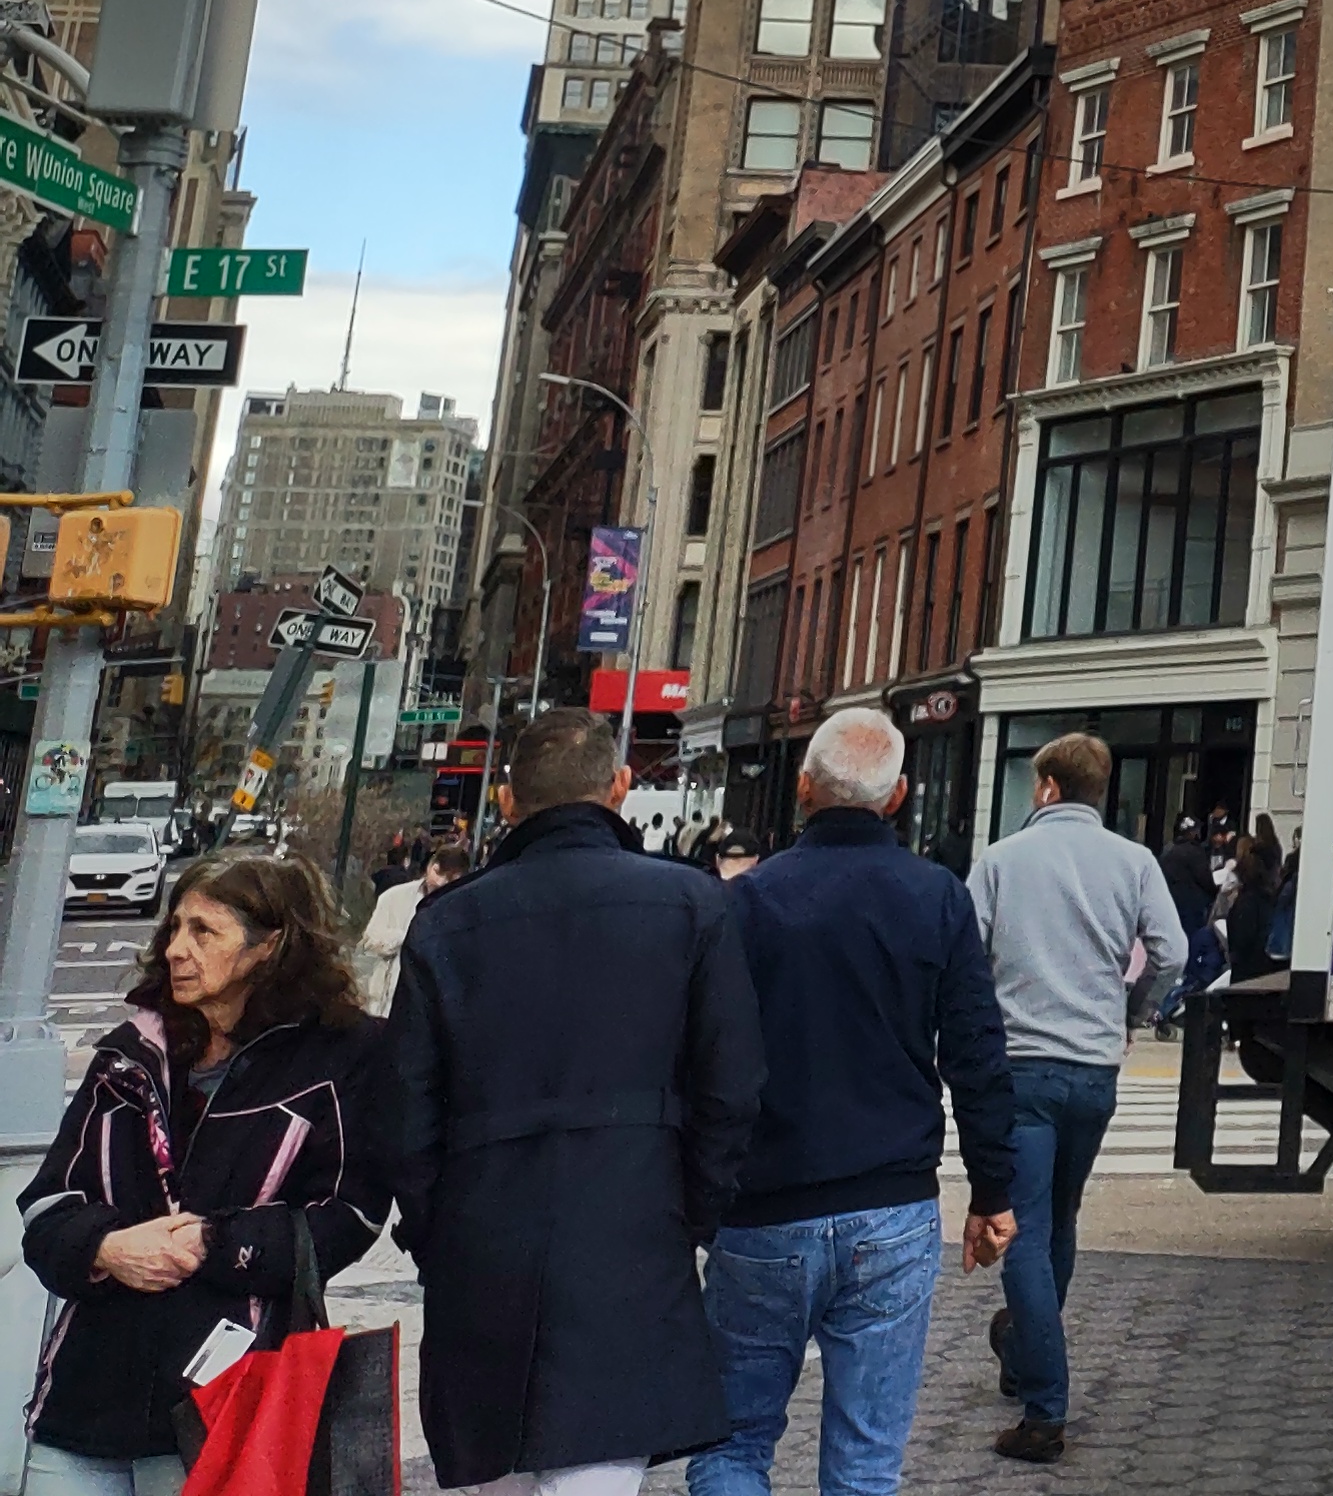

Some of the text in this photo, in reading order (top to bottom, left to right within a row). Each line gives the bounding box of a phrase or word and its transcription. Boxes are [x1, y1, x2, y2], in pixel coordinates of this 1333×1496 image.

[43, 152, 134, 213] Union Square
[183, 254, 287, 290] E 17 St
[56, 339, 213, 366] ON WAY
[329, 629, 360, 643] WAY
